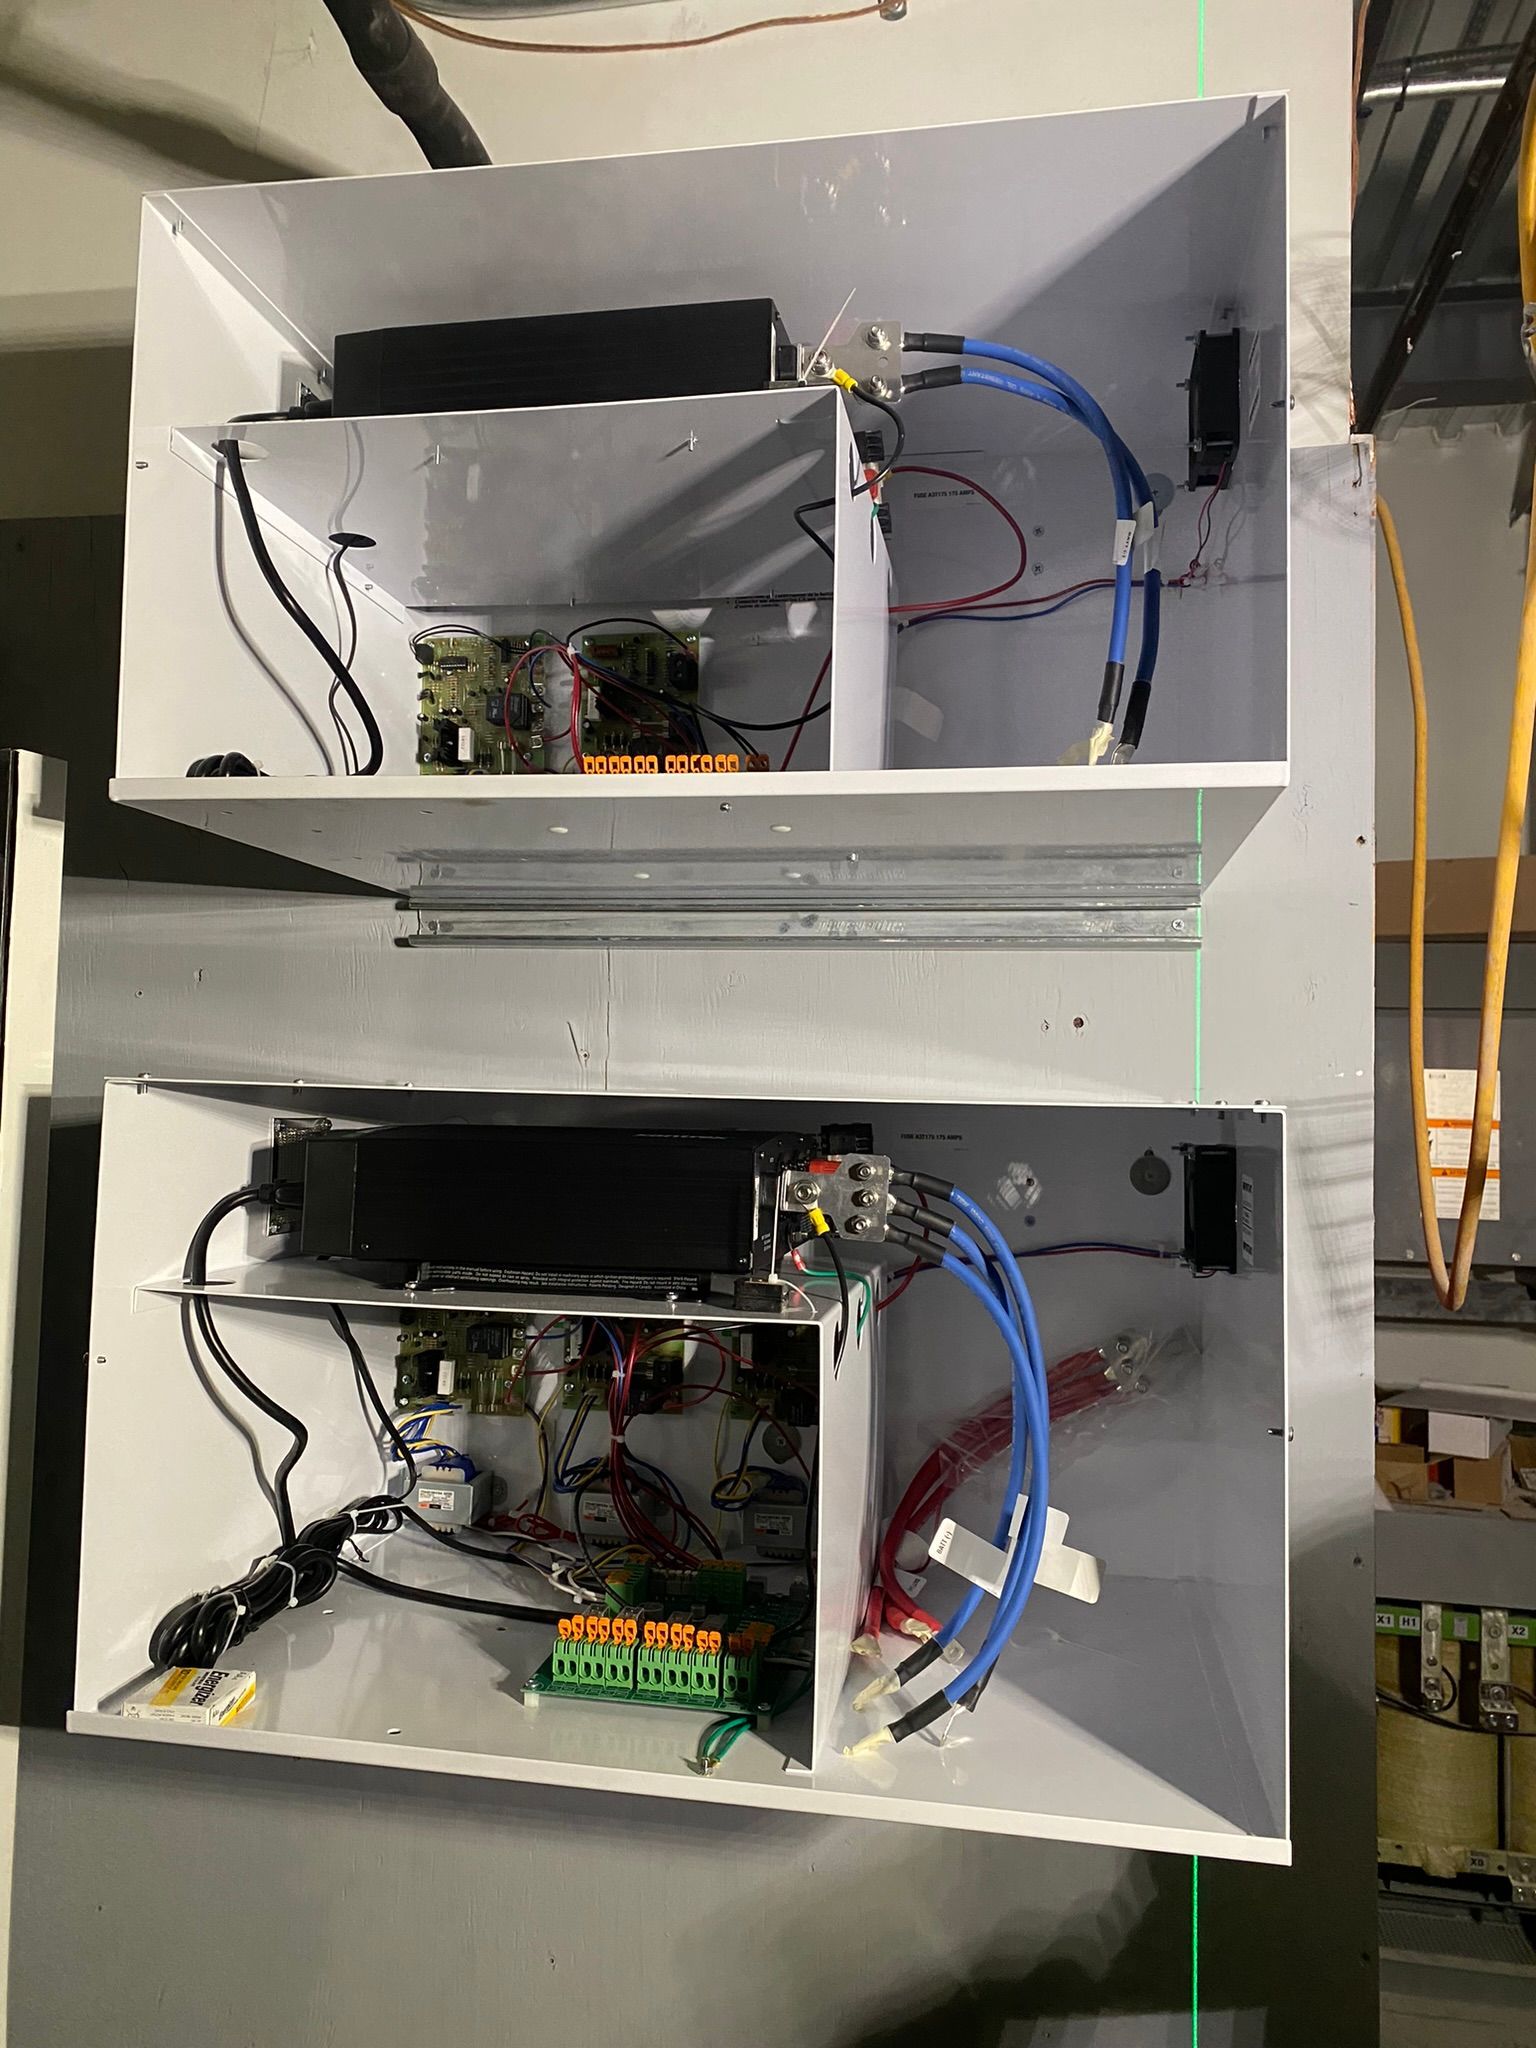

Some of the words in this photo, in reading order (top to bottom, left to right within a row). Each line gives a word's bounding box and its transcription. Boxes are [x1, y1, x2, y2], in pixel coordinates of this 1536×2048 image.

[936, 1538, 948, 1555] BATT
[1376, 1615, 1391, 1625] X1
[1402, 1617, 1416, 1627] H1
[1511, 1626, 1526, 1636] X2
[189, 1670, 230, 1706] Energizer
